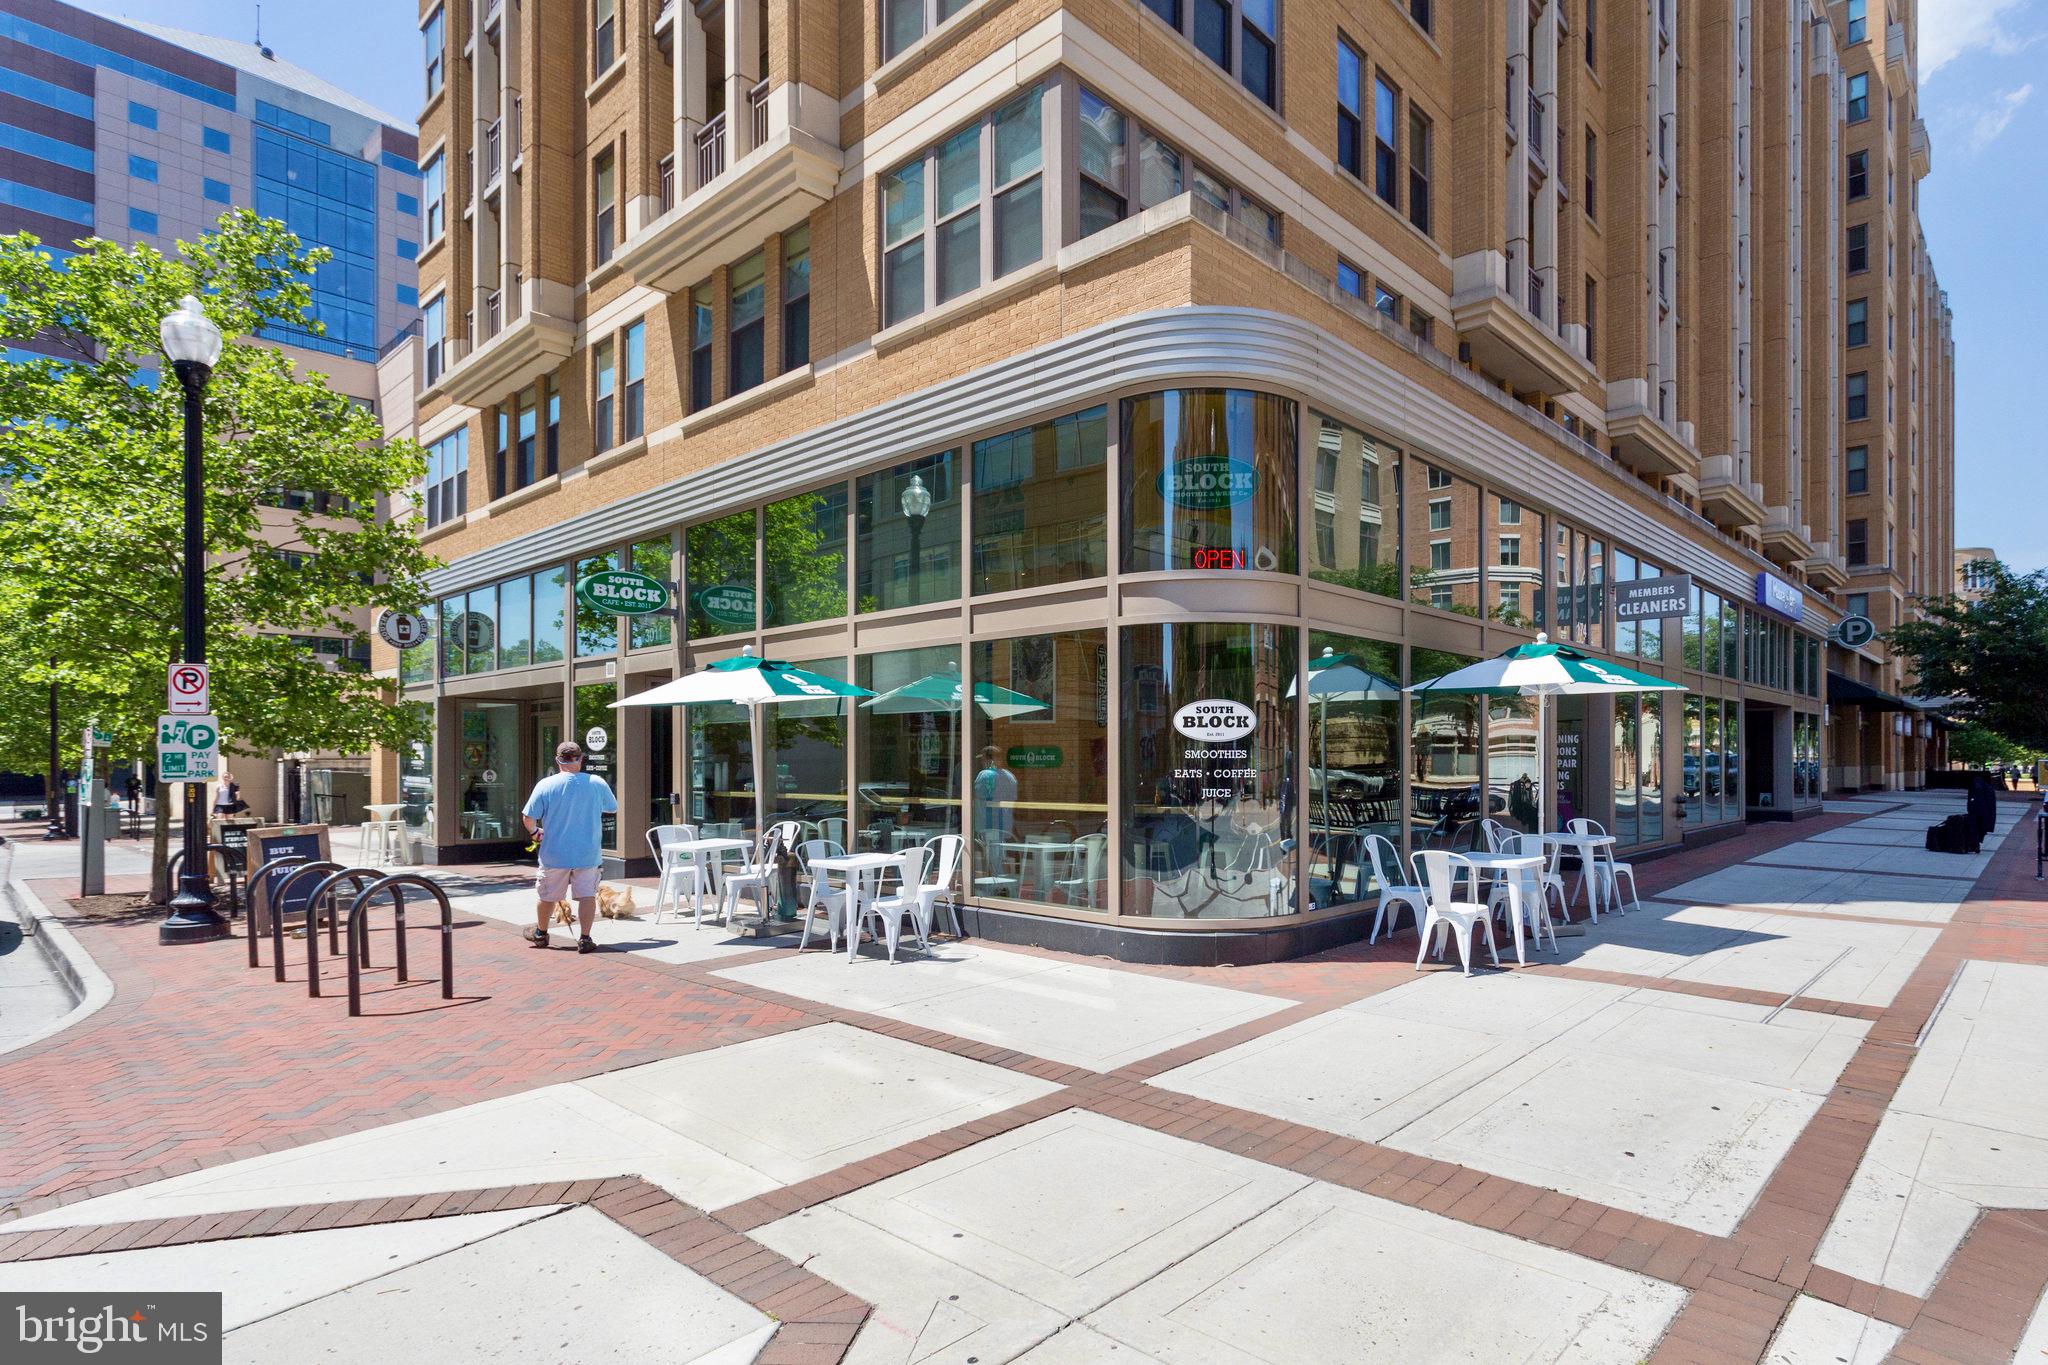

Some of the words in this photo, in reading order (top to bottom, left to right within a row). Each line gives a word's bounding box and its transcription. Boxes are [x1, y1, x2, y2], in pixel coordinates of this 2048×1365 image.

[1185, 463, 1229, 473] SOUTH
[1167, 473, 1253, 490] BLOCK
[1194, 549, 1245, 569] OPEN
[608, 575, 644, 587] SOUTH
[592, 583, 661, 603] BLOCK
[1628, 585, 1675, 599] MEMBERS
[1618, 597, 1687, 616] CLEANERS
[1846, 621, 1867, 642] P
[182, 672, 199, 690] P
[1195, 706, 1234, 714] SOUTH
[1182, 715, 1249, 728] BLOCK
[191, 729, 210, 746] P
[1557, 734, 1579, 744] NING
[165, 753, 172, 763] 2
[191, 751, 211, 759] PAY
[1184, 749, 1247, 759] SMOOTHIES
[163, 764, 185, 772] LIMIT
[195, 761, 209, 769] TO
[1557, 758, 1577, 768] PAIR
[1174, 769, 1202, 778] EATS
[1213, 768, 1257, 778] COFFEE
[1201, 788, 1232, 799] JUICE
[269, 846, 294, 855] BUT
[271, 865, 300, 877] JUIC
